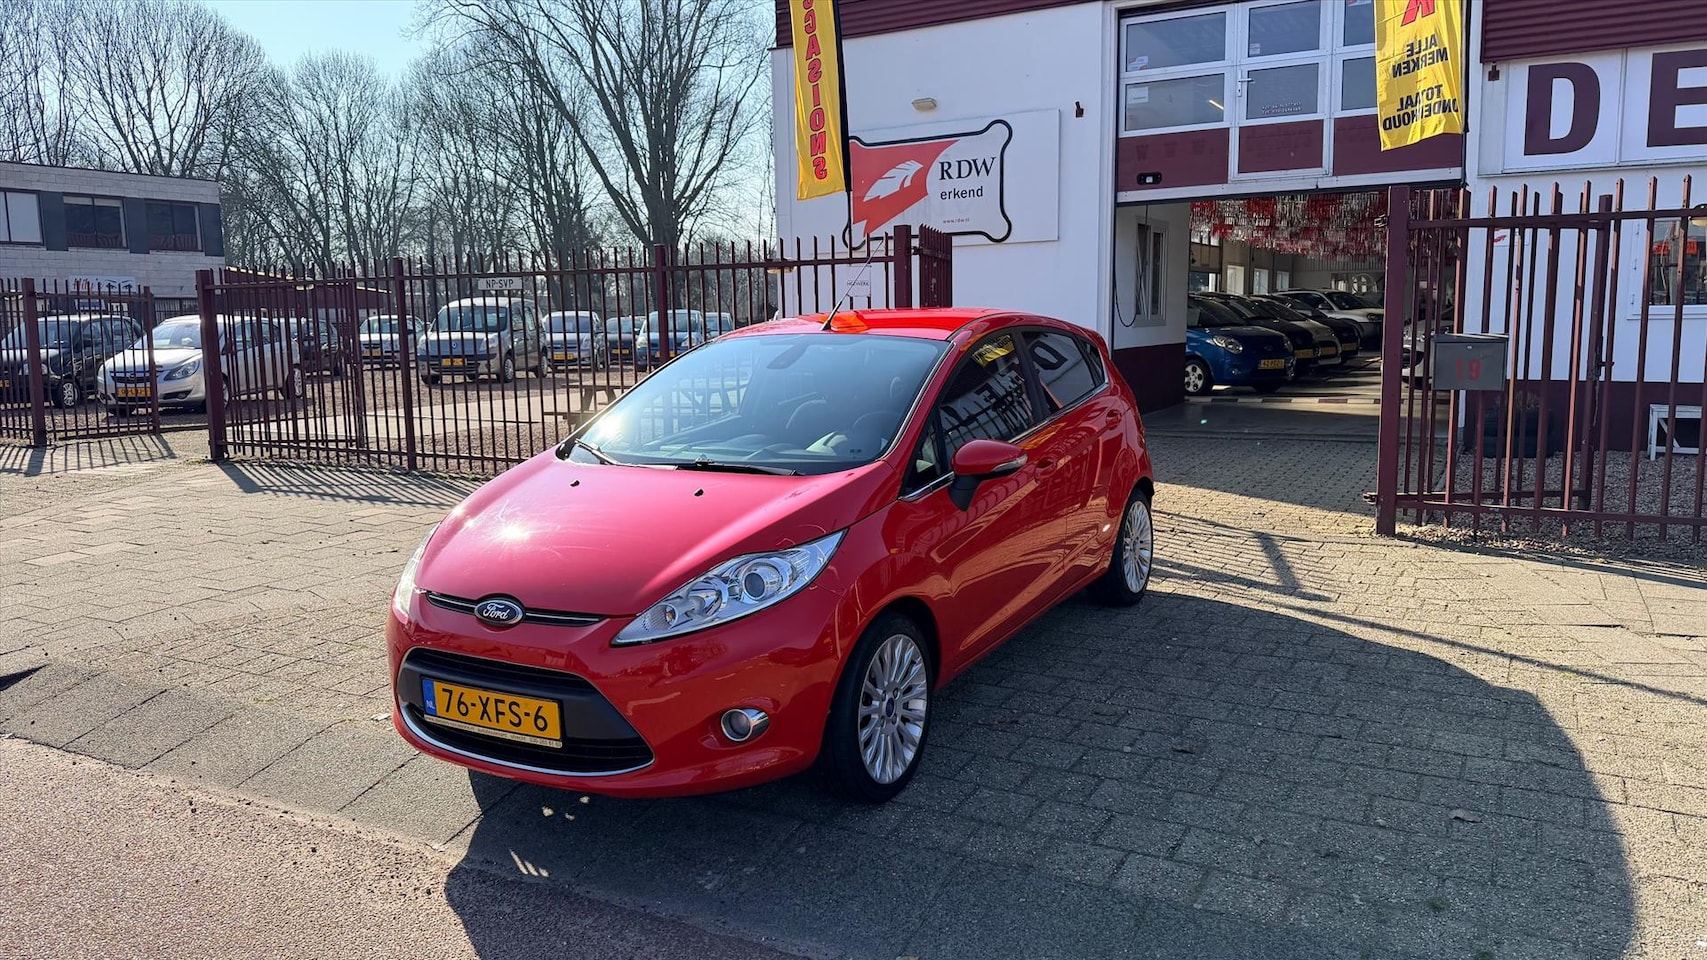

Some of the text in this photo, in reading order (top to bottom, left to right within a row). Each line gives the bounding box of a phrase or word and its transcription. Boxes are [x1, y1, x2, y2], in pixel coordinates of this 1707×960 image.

[939, 156, 997, 181] RDW
[940, 185, 984, 200] erkend
[485, 278, 514, 289] NP-SVP
[1455, 357, 1483, 384] 19
[482, 602, 511, 620] Ford
[441, 687, 548, 732] 76-XFS-6
